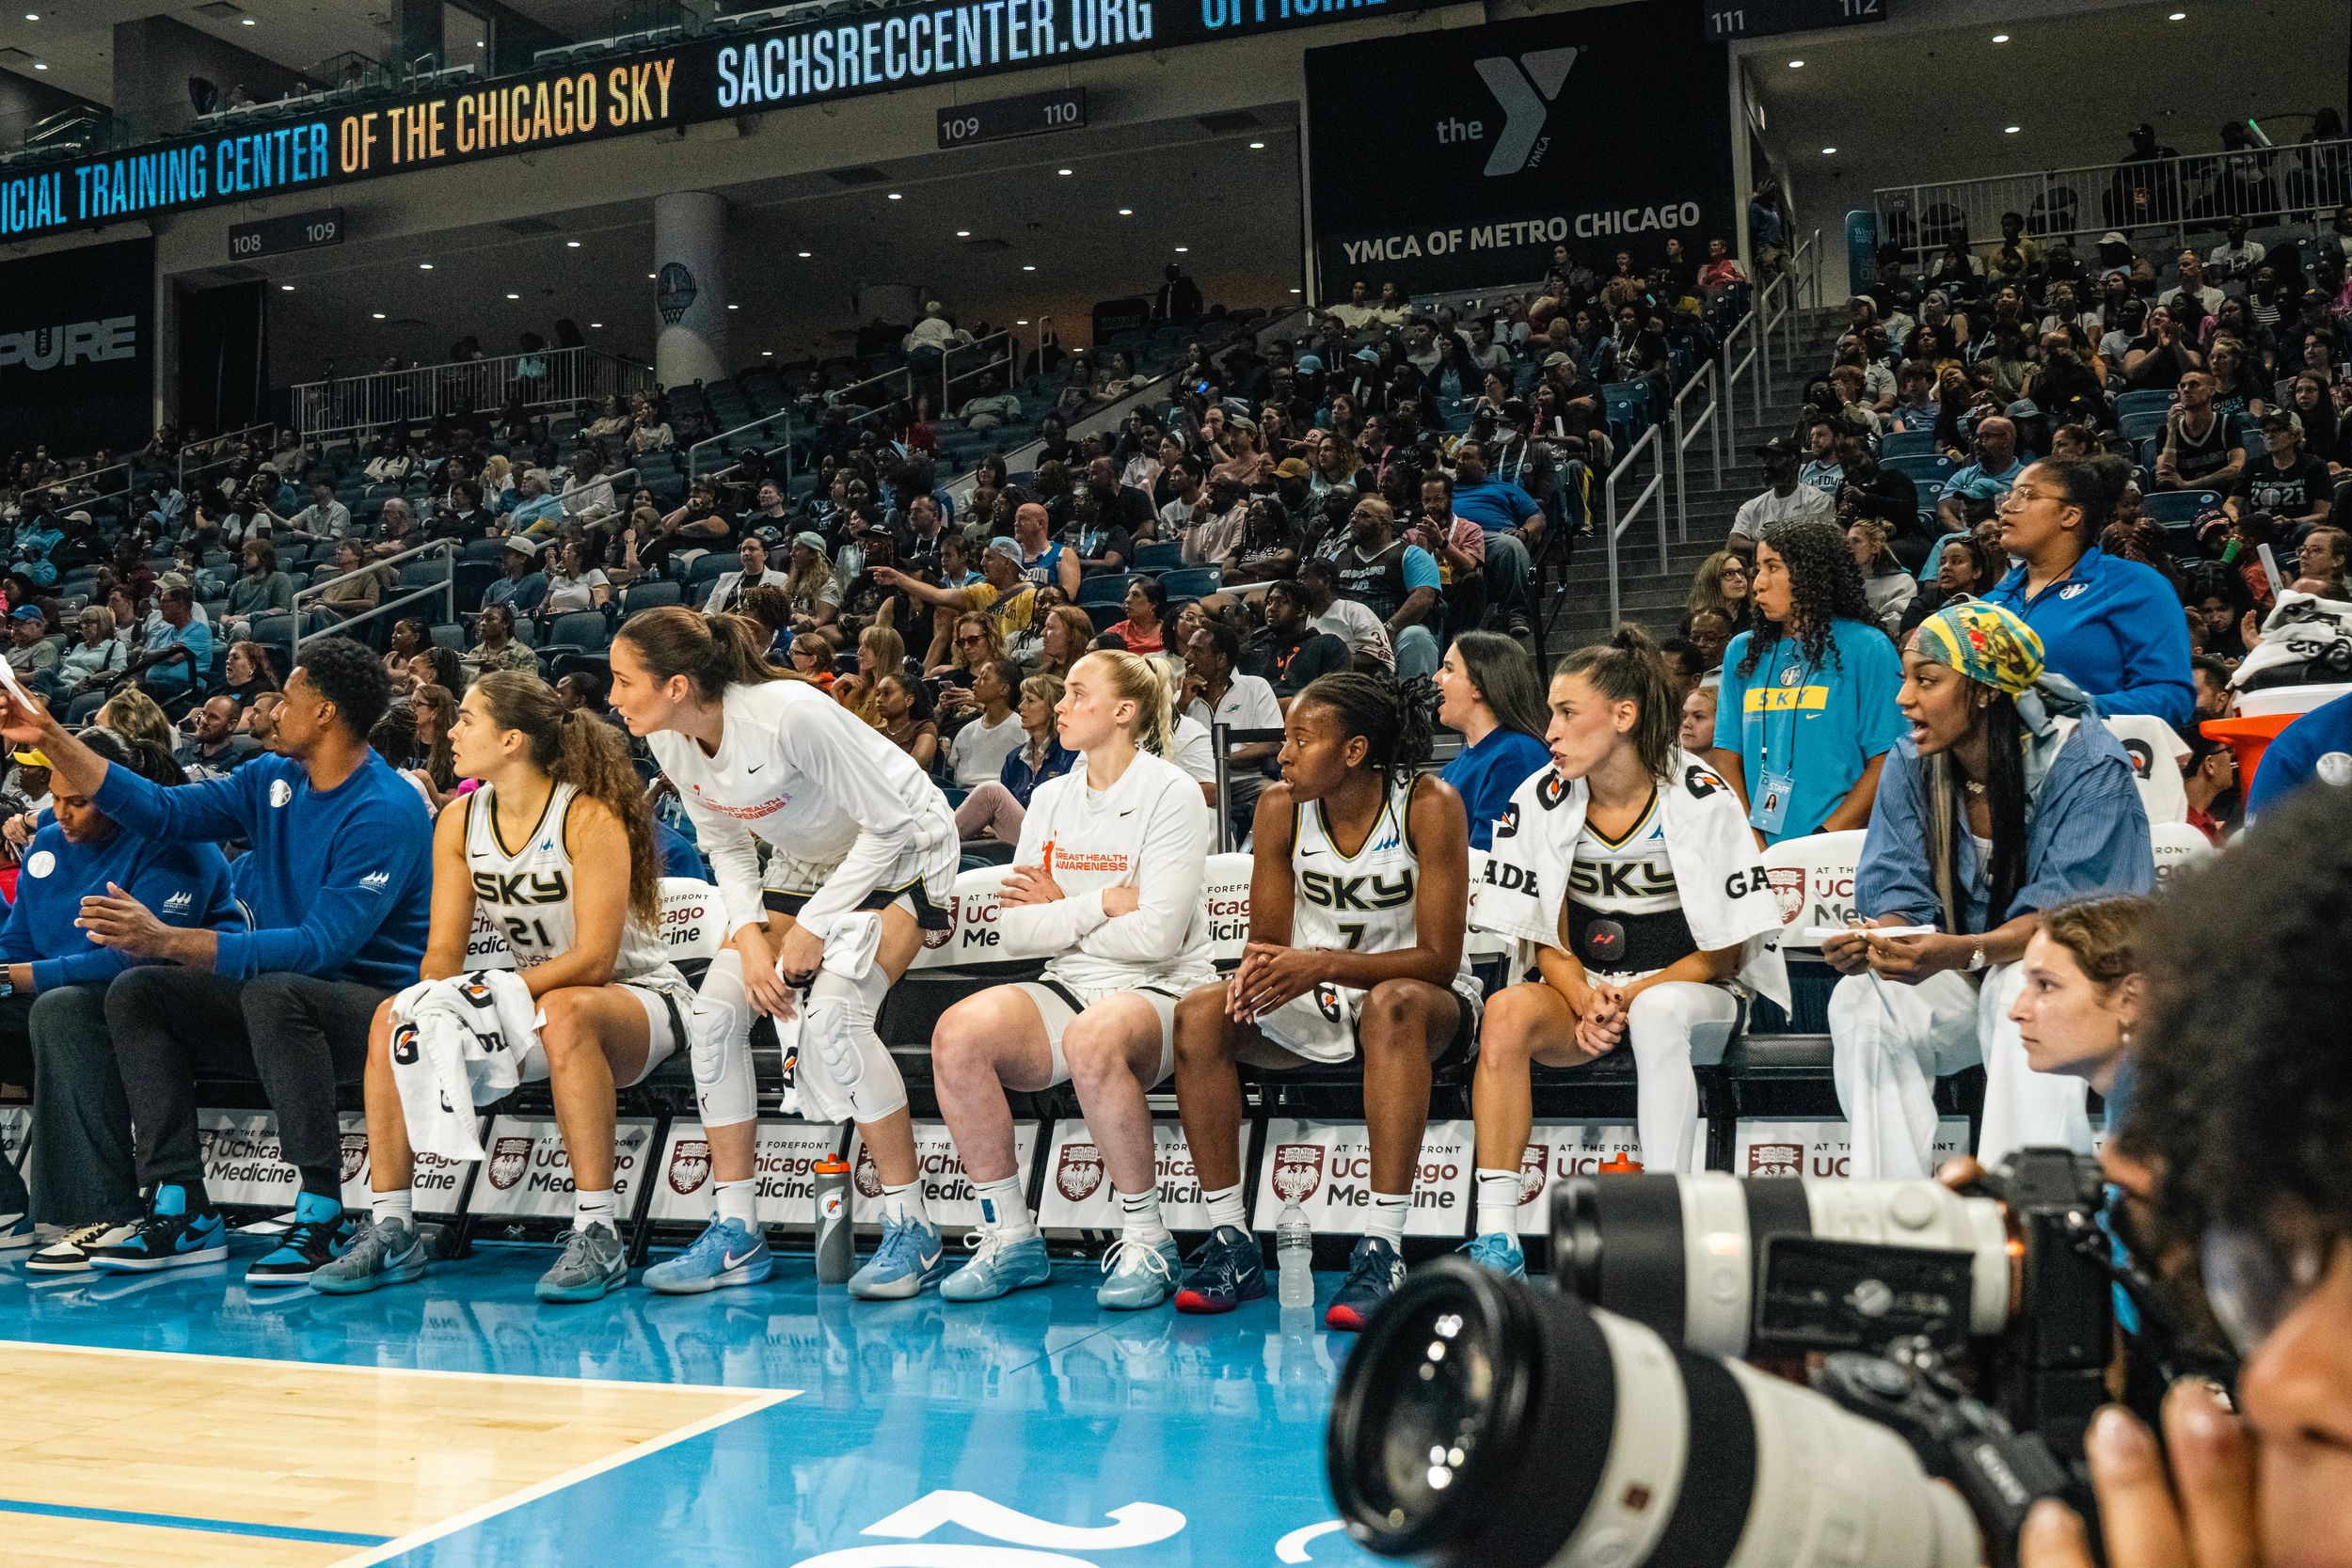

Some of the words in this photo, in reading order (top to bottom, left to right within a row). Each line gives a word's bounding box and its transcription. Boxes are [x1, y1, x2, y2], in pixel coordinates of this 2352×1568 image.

[1842, 0, 1878, 17] 112
[1712, 8, 1745, 35] 111
[717, 0, 1153, 108] SACHSRECCENTER.ORG
[1042, 102, 1078, 126] 110
[942, 116, 980, 142] 109
[1436, 118, 1484, 144] the
[0, 171, 68, 235] ICIAL
[75, 145, 207, 221] TRAINING
[216, 121, 329, 196] CENTER
[341, 113, 379, 174] OF
[387, 97, 446, 165] THE
[456, 71, 598, 153] CHICAGO
[607, 57, 676, 128] SKY
[1526, 135, 1552, 168] YMCA
[306, 221, 337, 244] 109
[1343, 234, 1421, 267] YMCA
[1427, 230, 1464, 257] OF
[1470, 215, 1569, 250] METRO
[1575, 201, 1700, 237] CHICAGO
[232, 234, 262, 256] 108
[1758, 689, 1809, 706] SKY
[1768, 782, 1791, 795] STAFF
[1055, 861, 1128, 872] AWARENESS
[1086, 854, 1128, 863] HEALTH
[1567, 860, 1680, 899] SKY
[1815, 866, 1830, 875] AT
[472, 870, 569, 905] SKY
[1207, 883, 1250, 894] FOREFR
[1302, 867, 1415, 911] SKY
[502, 916, 552, 947] 21
[1337, 923, 1368, 950] 7
[240, 1129, 255, 1137] THE
[218, 1140, 283, 1163] UChica
[767, 1140, 831, 1149] FOREFRONT
[931, 1141, 952, 1150] THE
[1334, 1144, 1349, 1152] AT
[1558, 1144, 1574, 1152] AT
[1582, 1144, 1606, 1152] THE
[1814, 1143, 1830, 1151] AT
[209, 1161, 296, 1183] Medicine
